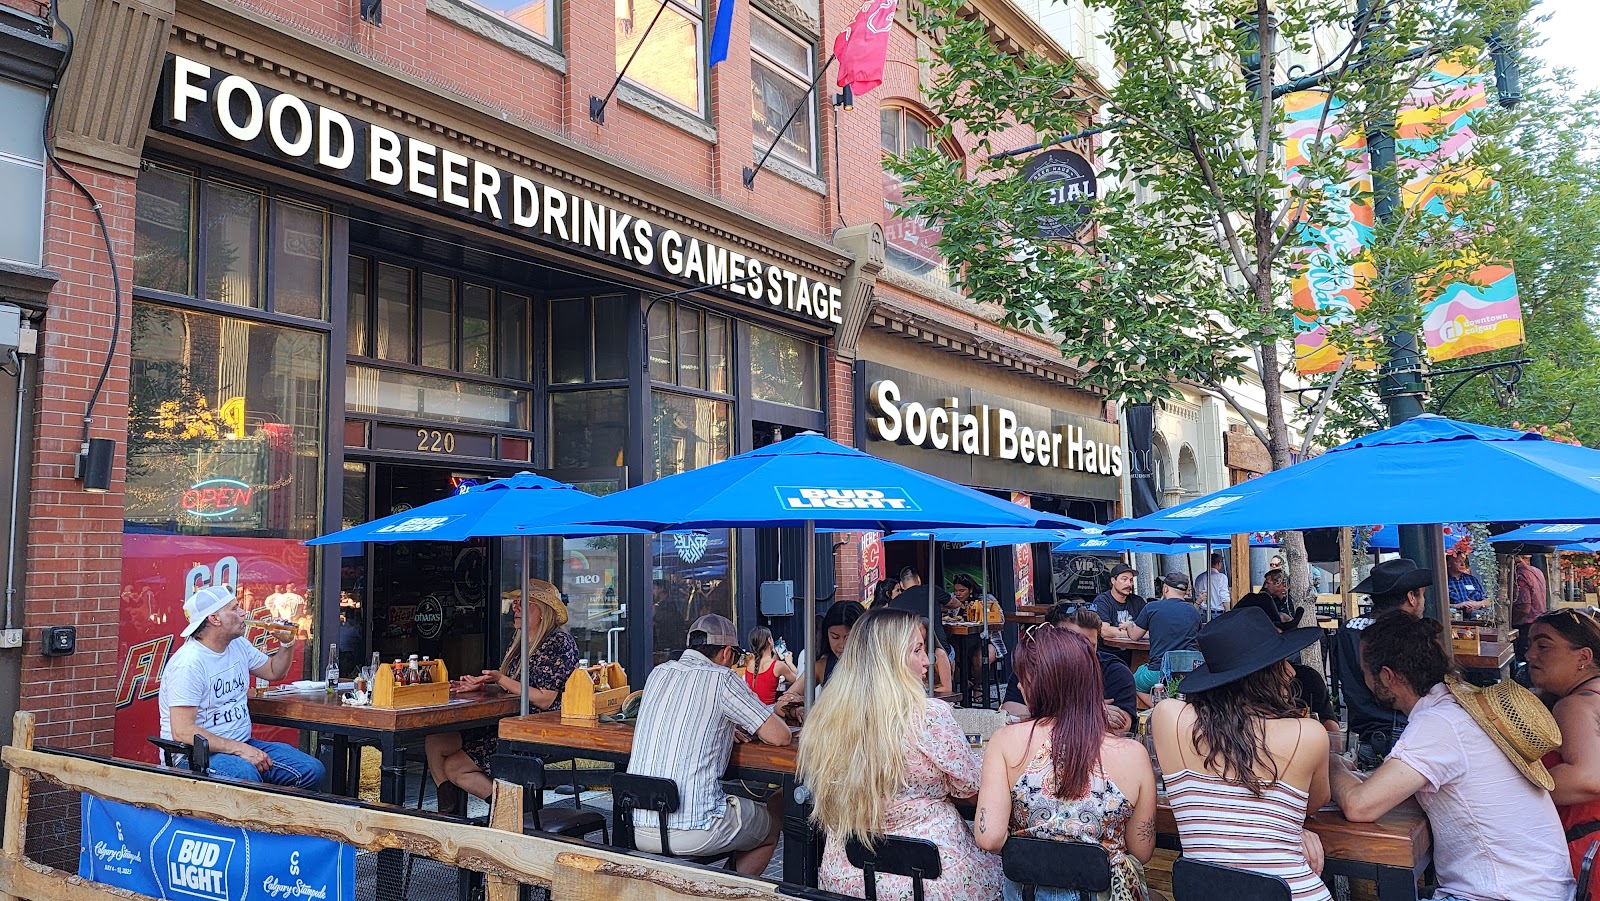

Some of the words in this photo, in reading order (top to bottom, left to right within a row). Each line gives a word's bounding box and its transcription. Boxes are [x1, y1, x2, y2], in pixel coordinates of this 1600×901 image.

[171, 55, 356, 171] FOOD
[367, 123, 503, 221] BEER
[511, 176, 654, 267] DRINKS
[659, 231, 765, 300] GAMES
[766, 266, 843, 325] STAGE
[1463, 313, 1508, 327] downtown
[1464, 323, 1498, 335] calgary
[876, 379, 990, 457] Social
[999, 408, 1063, 469] Beer
[1067, 425, 1123, 478] Haus
[416, 428, 455, 453] 220
[181, 487, 253, 509] OPEN
[787, 497, 907, 509] LIGHT
[799, 488, 885, 499] BUD
[1075, 560, 1094, 572] VIP
[575, 573, 601, 585] neo
[94, 840, 118, 863] Calgary
[177, 838, 221, 868] BUD
[170, 862, 224, 895] LIGHT
[263, 875, 293, 900] Calgary
[292, 879, 327, 901] Stampede
